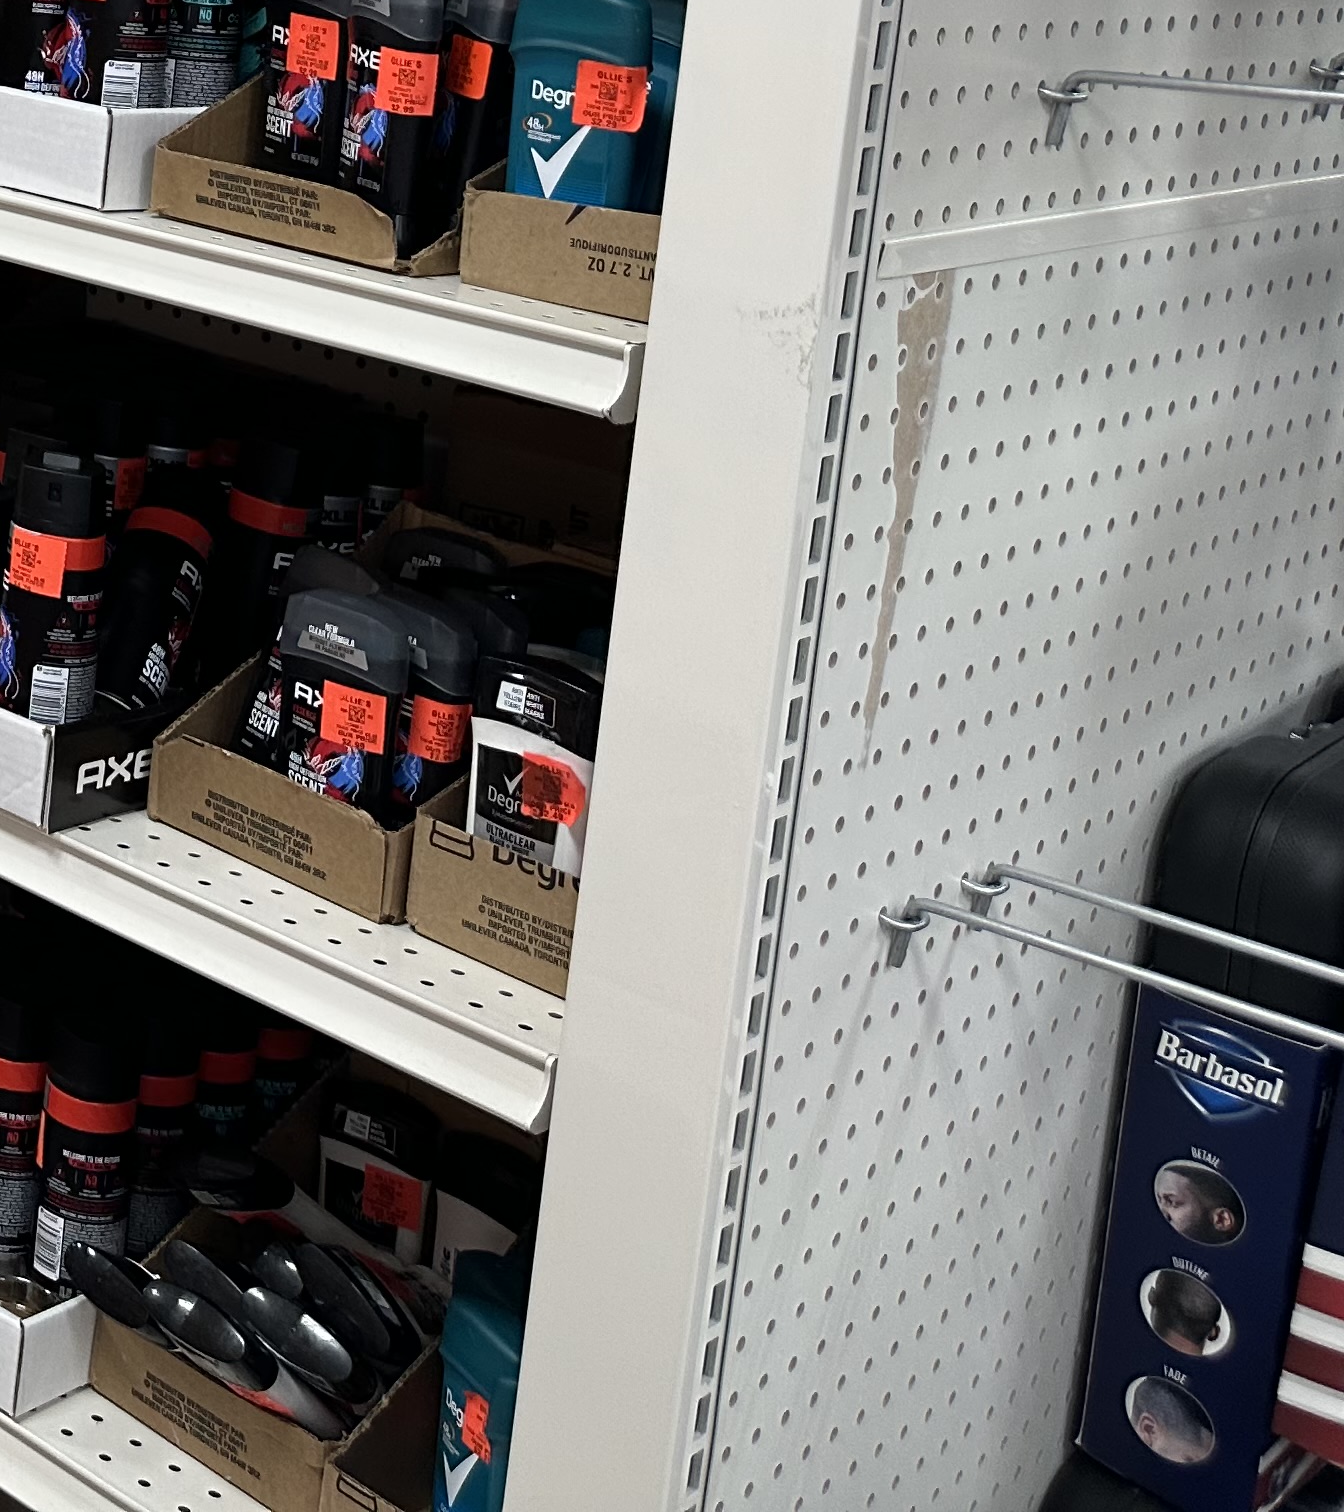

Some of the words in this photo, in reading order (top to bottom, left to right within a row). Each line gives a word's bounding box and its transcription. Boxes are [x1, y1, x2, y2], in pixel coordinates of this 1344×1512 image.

[350, 43, 380, 70] AXE
[391, 56, 422, 68] OLLIE'S
[25, 70, 44, 83] 48H
[266, 117, 293, 137] SCENT
[526, 116, 545, 131] 48H
[588, 256, 605, 273] OZ
[248, 707, 280, 738] SCENT
[76, 748, 153, 794] AXE
[288, 769, 327, 797] SCENT
[486, 821, 536, 852] ULTRACLEAR
[481, 895, 530, 921] DISTRIBUTED
[1155, 1029, 1285, 1105] Barbasol
[1171, 1256, 1211, 1283] OUTLINE
[1163, 1364, 1188, 1387] FADE
